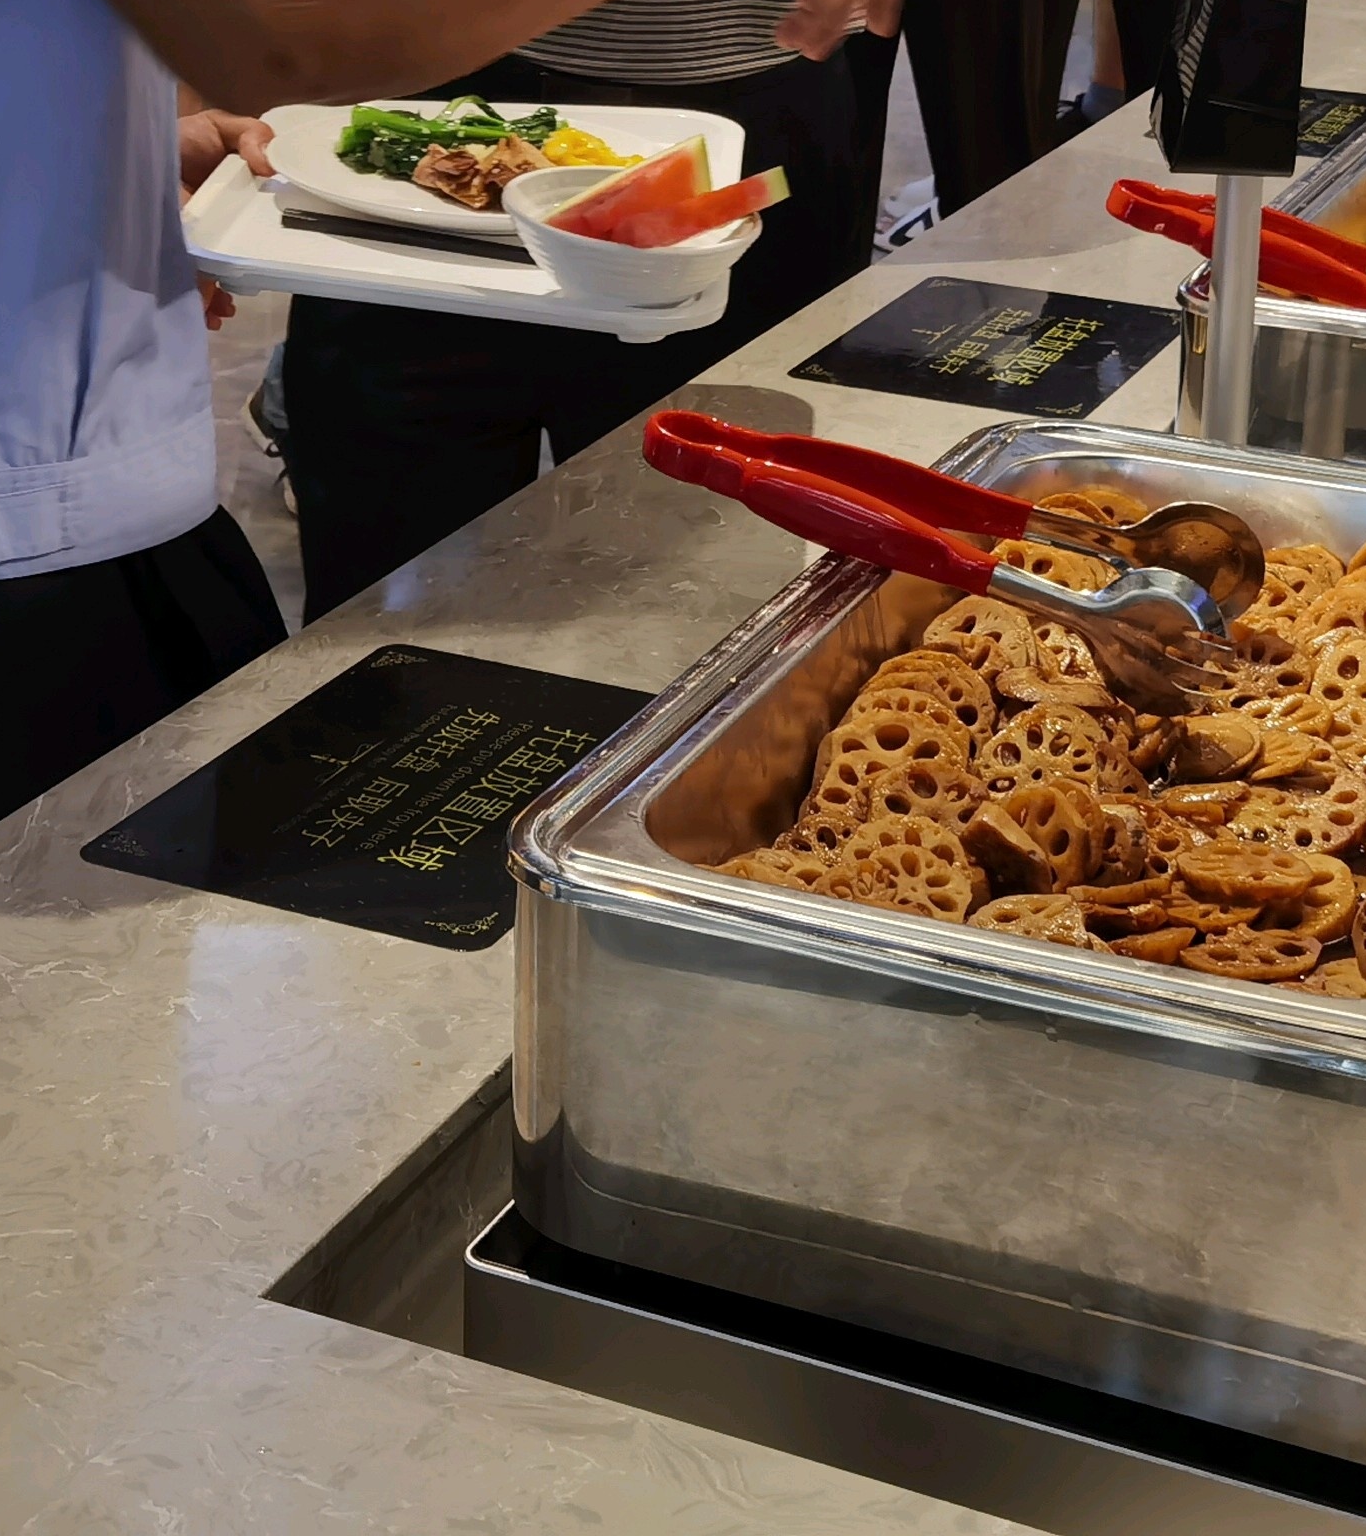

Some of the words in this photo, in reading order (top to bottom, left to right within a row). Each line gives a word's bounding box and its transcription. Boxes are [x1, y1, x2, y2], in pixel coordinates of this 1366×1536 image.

[392, 707, 500, 773] 先放托盘
[301, 776, 410, 848] 后取夹子
[377, 724, 598, 871] 托盘放置区域
[434, 765, 474, 791] down
